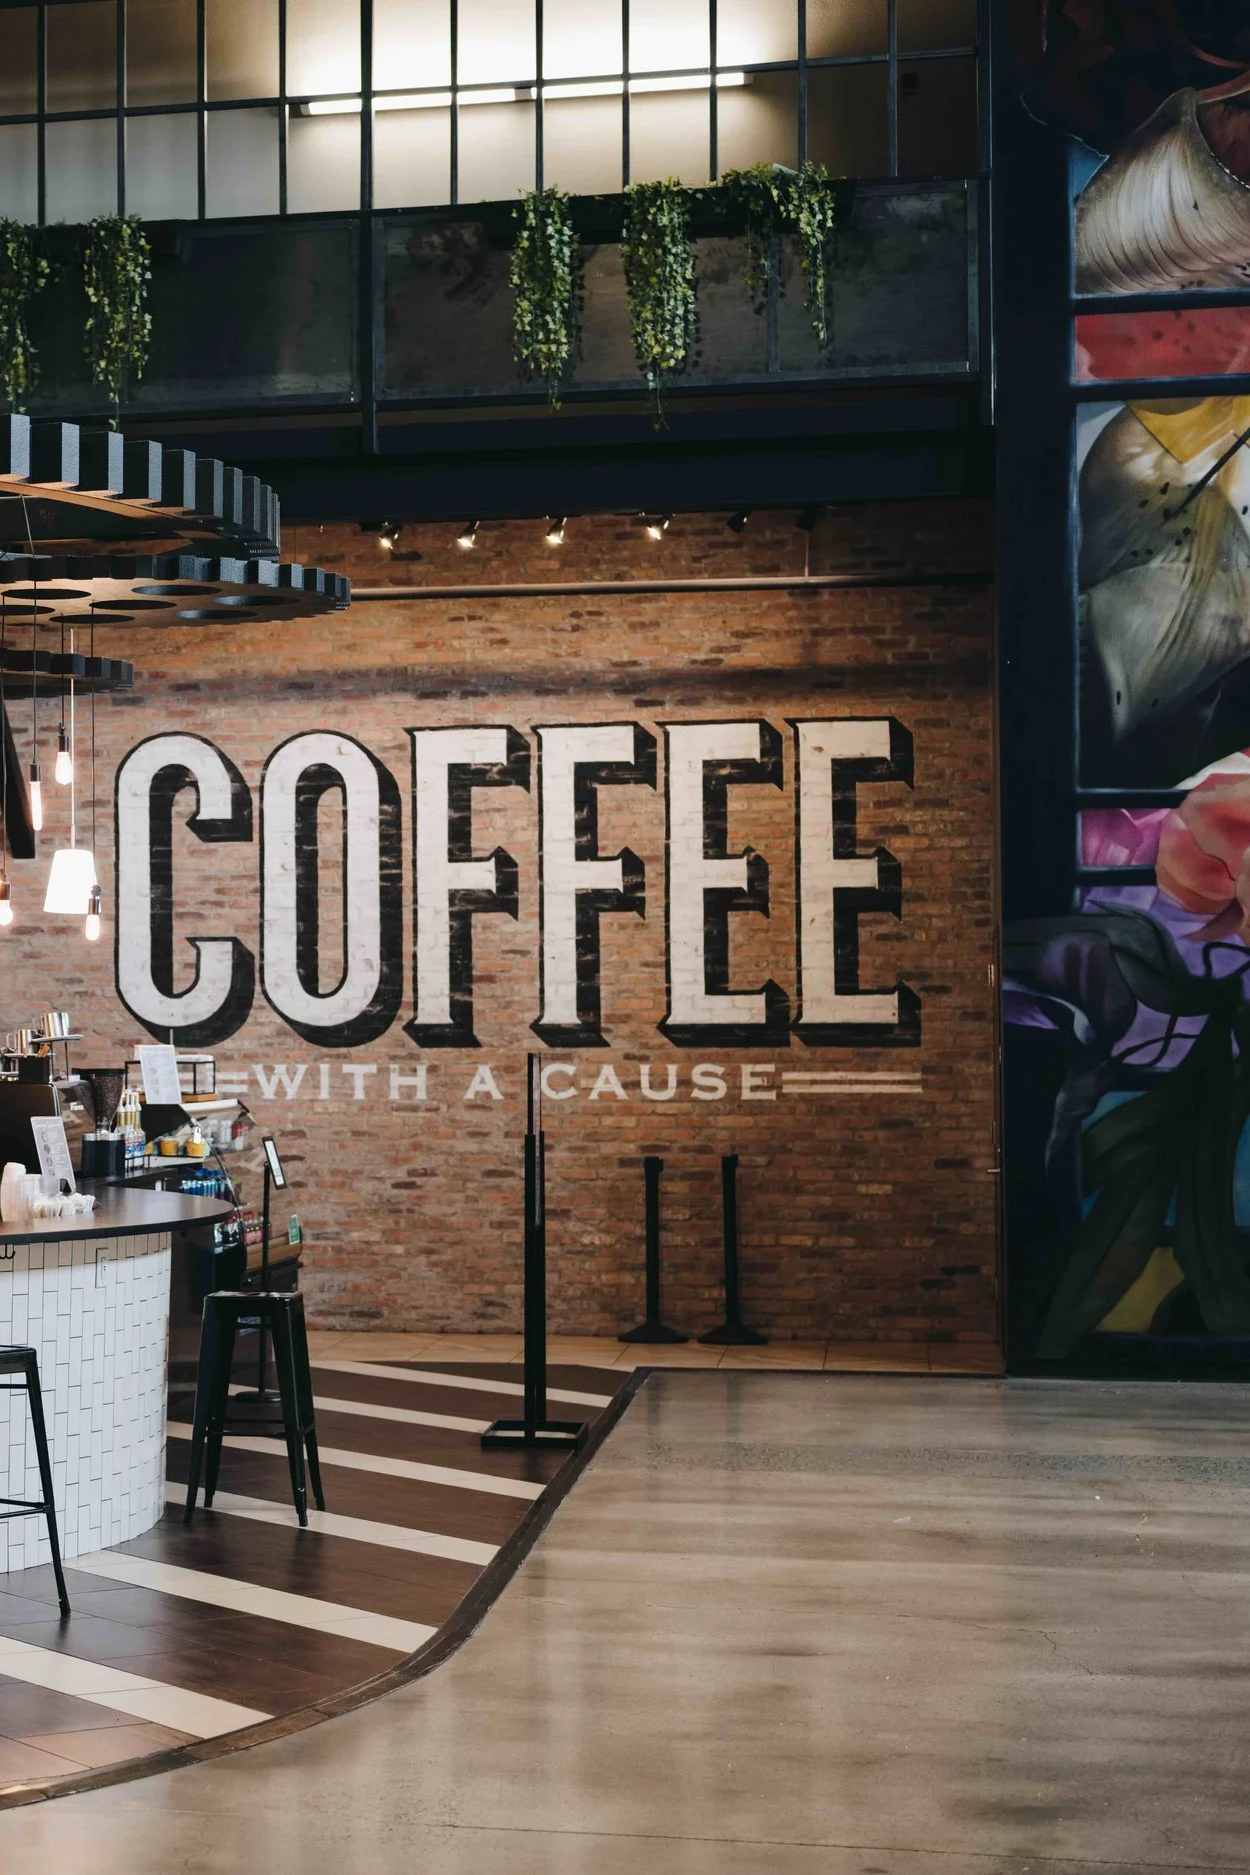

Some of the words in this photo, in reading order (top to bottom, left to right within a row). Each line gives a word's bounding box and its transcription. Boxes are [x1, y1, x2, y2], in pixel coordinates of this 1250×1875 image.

[114, 717, 923, 1049] COFFEE
[252, 1063, 427, 1100] WITH
[463, 1064, 505, 1100] A
[540, 1063, 777, 1101] CAUSE
